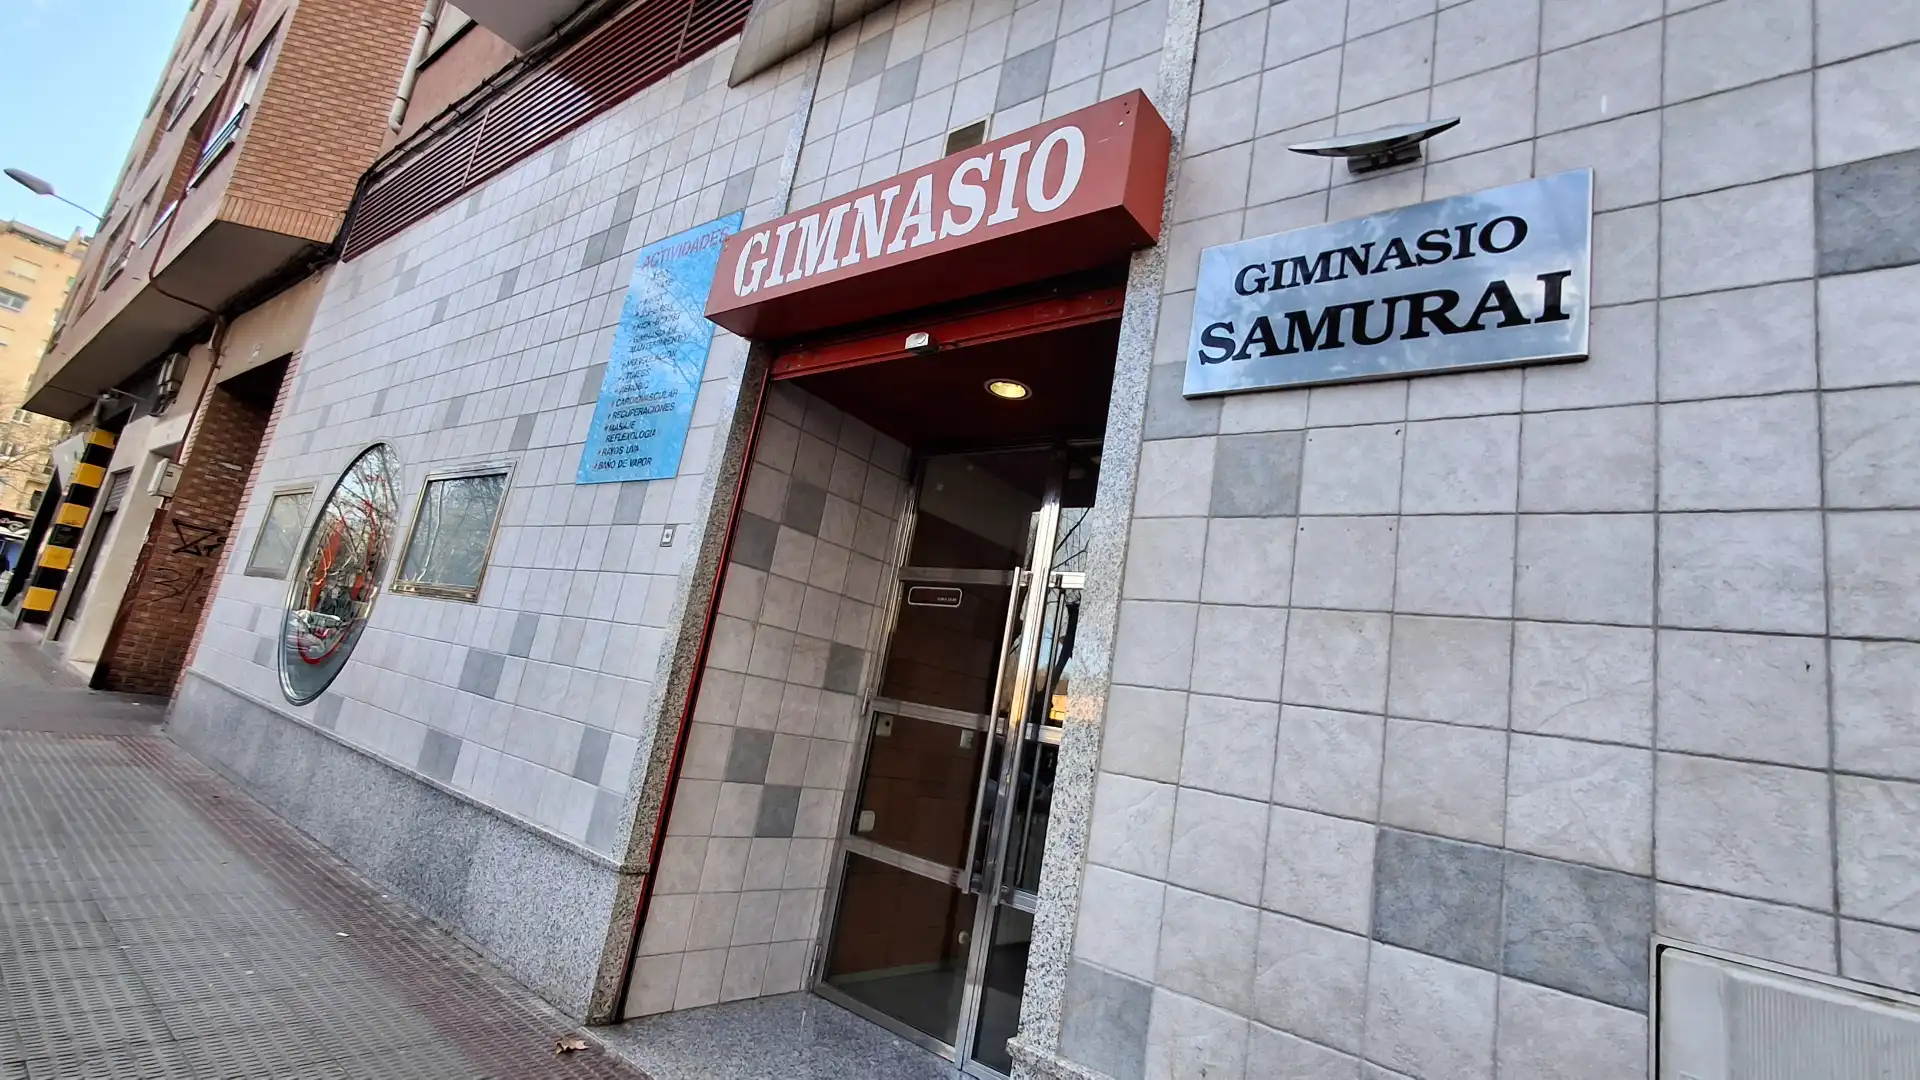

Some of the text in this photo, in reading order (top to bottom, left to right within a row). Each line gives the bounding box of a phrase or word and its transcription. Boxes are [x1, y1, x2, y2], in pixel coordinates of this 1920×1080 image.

[733, 125, 1086, 297] GIMNASIO
[641, 226, 730, 270] ACTIVIDADES
[1234, 215, 1528, 296] GIMNASIO
[1199, 269, 1572, 365] SAMURAI
[616, 388, 678, 407] CARDIOVASCULAR
[612, 402, 676, 419] RECUPERACIONES
[608, 420, 636, 432] MASAJE
[605, 428, 656, 443] REFLEXOLOGIA
[601, 445, 640, 456] RAYOS UVA
[597, 457, 653, 470] BAÑO DE VAPOR
